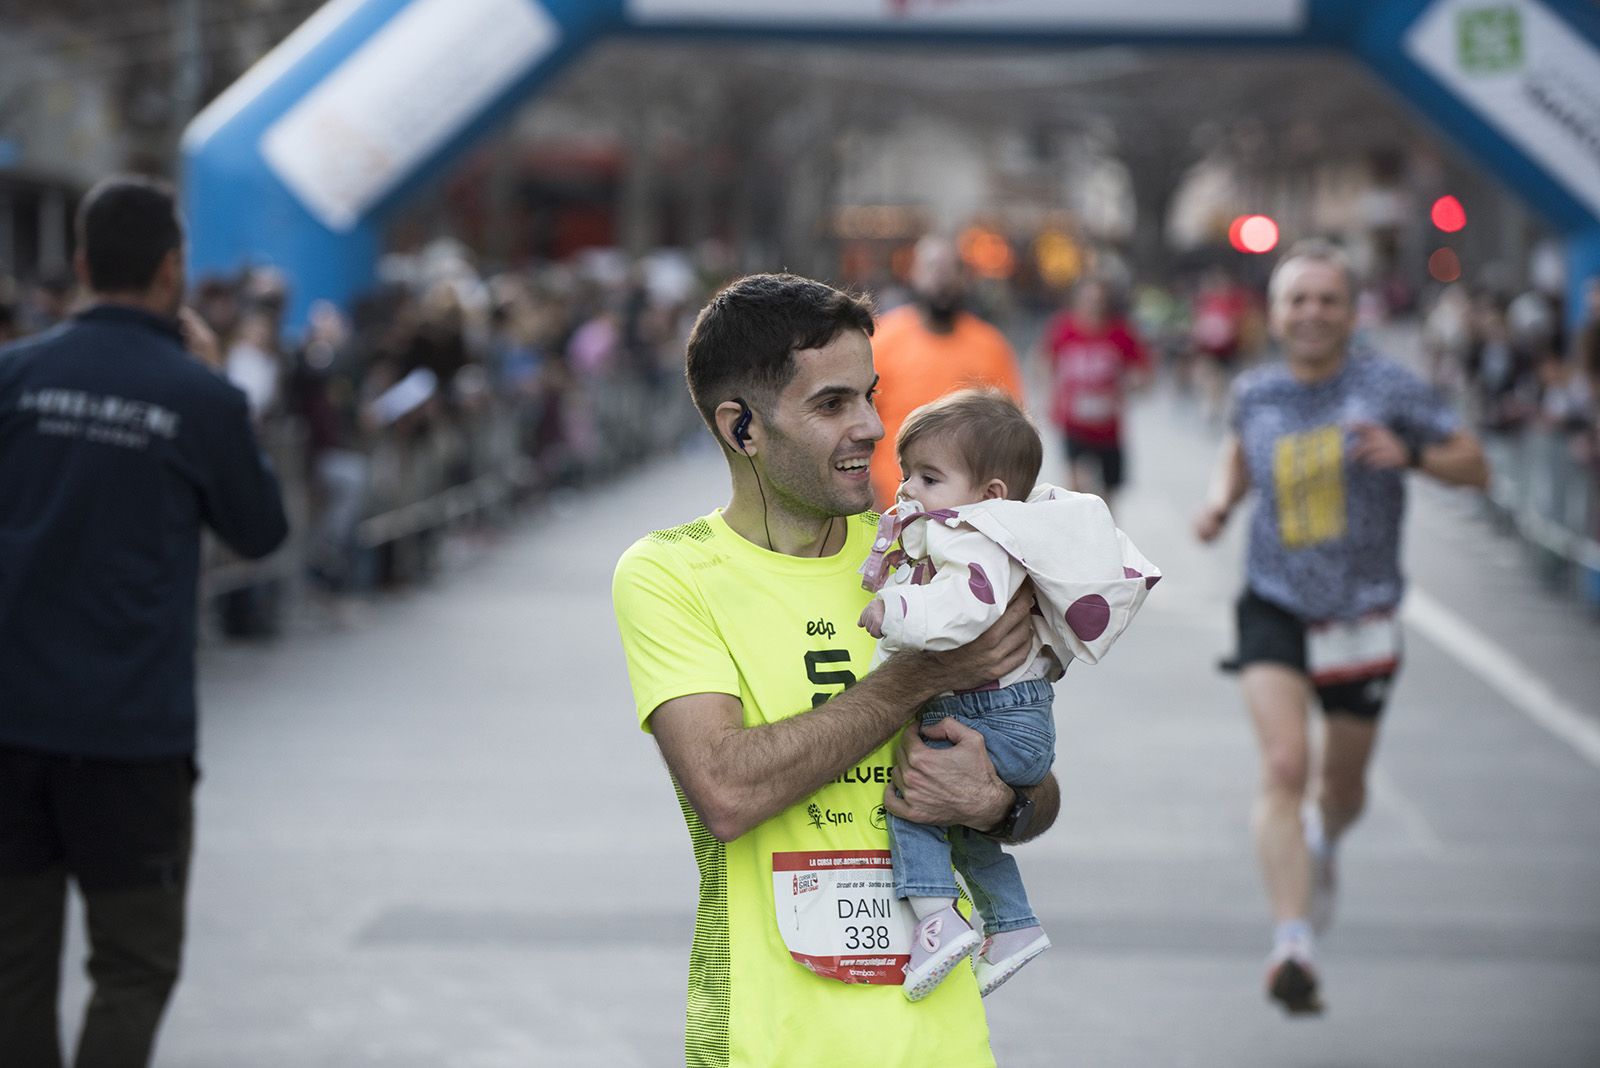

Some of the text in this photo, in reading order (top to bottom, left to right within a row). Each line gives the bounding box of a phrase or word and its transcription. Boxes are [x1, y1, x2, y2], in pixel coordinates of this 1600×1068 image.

[806, 617, 836, 640] edp
[838, 899, 891, 918] DANI
[845, 926, 890, 950] 338
